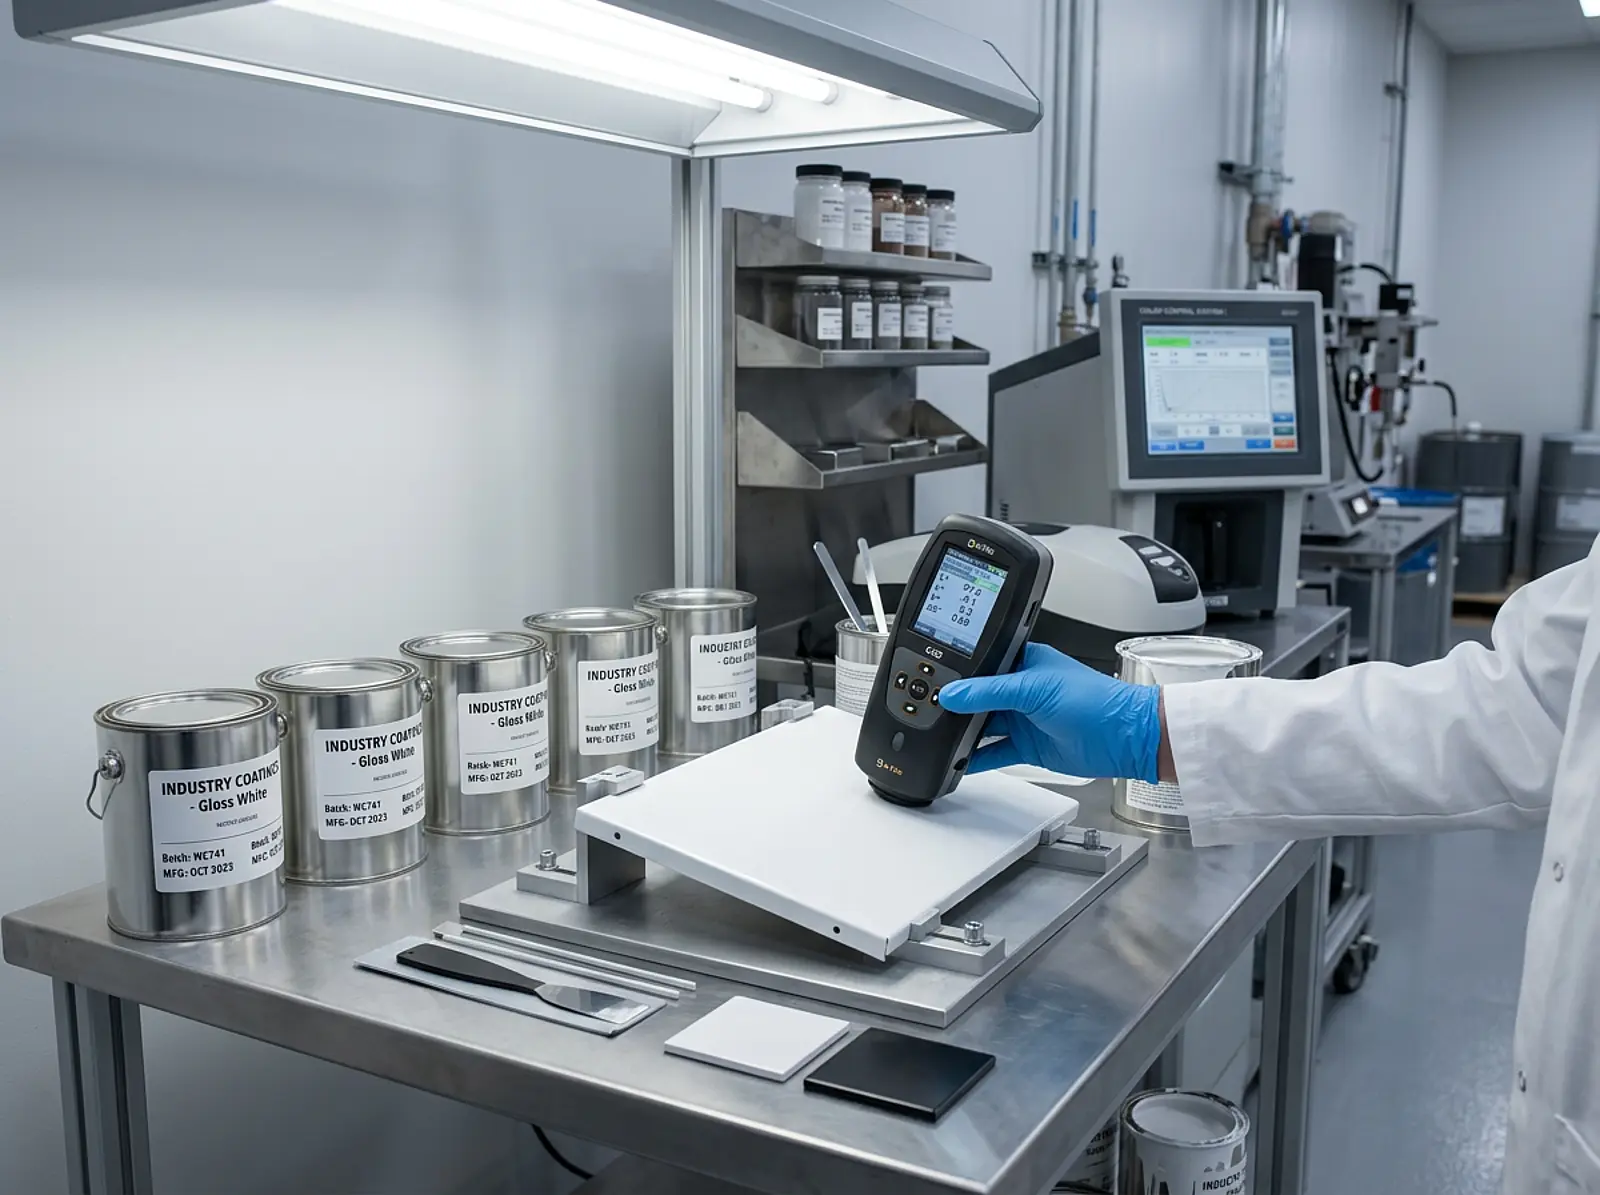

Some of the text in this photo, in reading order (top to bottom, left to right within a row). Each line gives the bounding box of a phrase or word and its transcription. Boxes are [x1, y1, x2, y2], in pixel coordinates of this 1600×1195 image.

[587, 666, 637, 681] INDUSTRY
[468, 697, 523, 714] INDUSTRY
[498, 715, 524, 727] Gloss
[325, 735, 388, 752] INDUSTRY
[358, 754, 389, 768] Gloss
[161, 777, 232, 795] INDUSTRY
[198, 798, 234, 812] Gloss
[237, 787, 268, 806] White
[367, 812, 388, 824] 2023
[163, 868, 189, 878] MFG:
[190, 866, 209, 877] OCT
